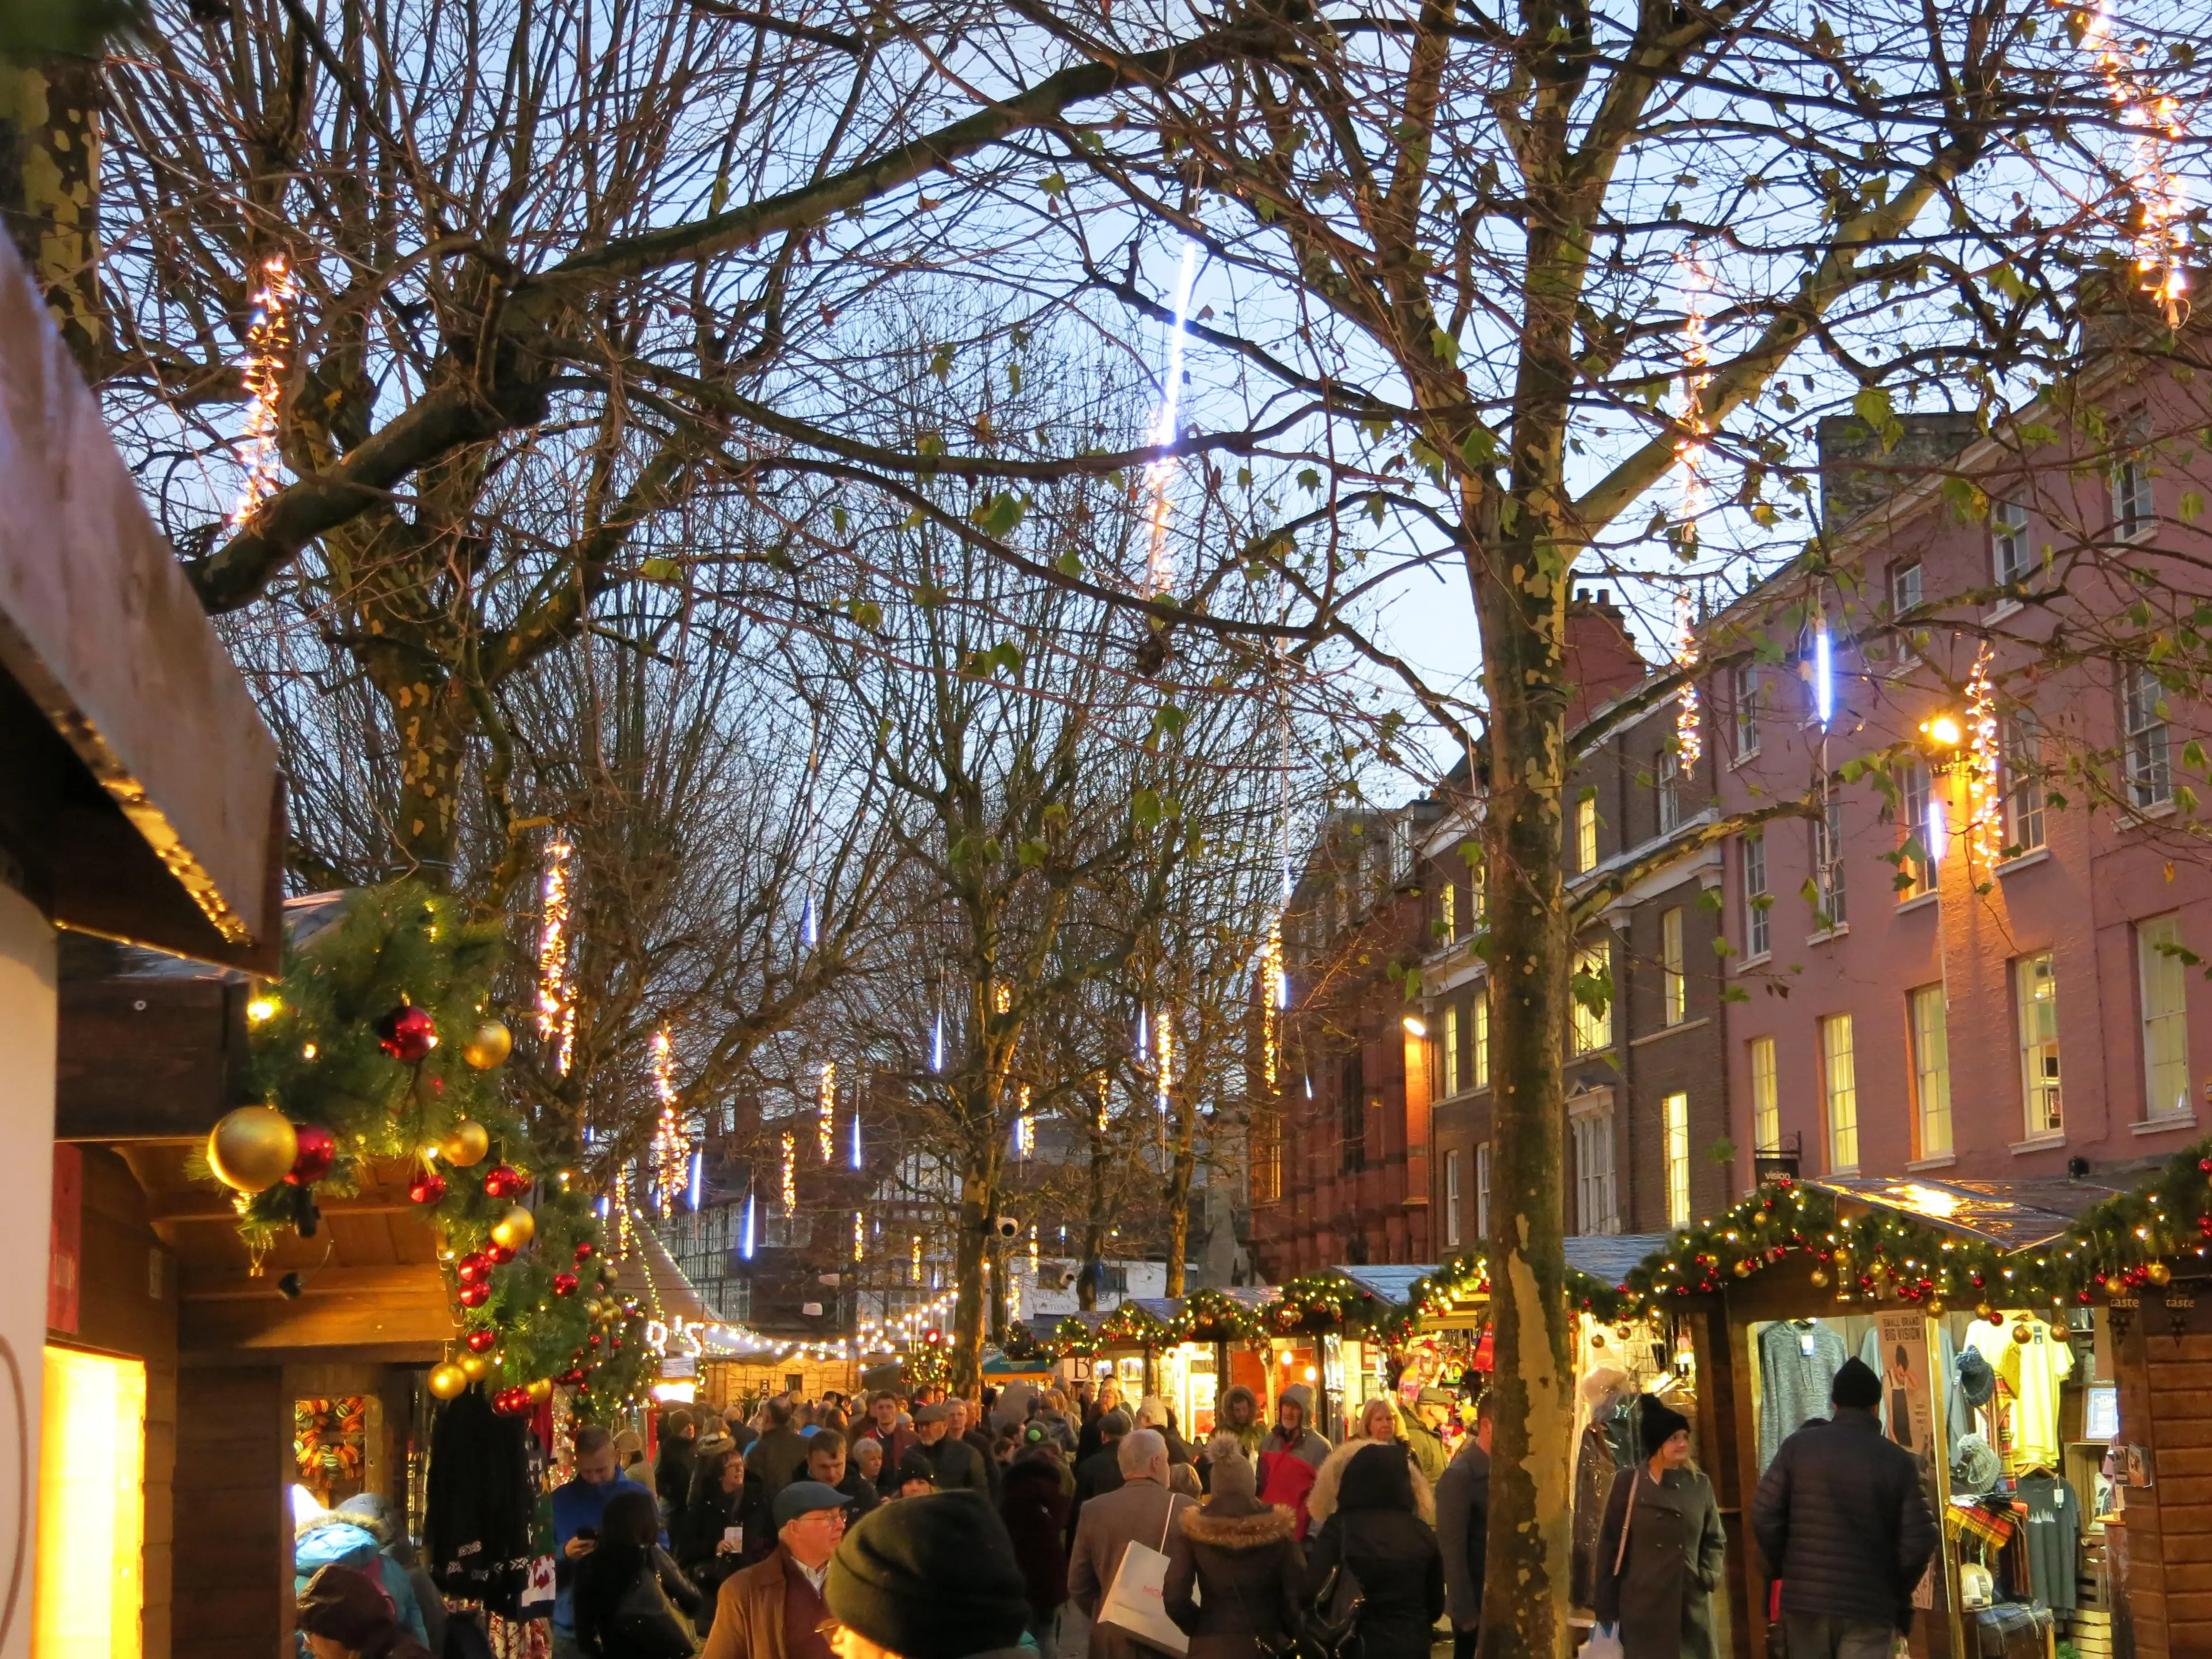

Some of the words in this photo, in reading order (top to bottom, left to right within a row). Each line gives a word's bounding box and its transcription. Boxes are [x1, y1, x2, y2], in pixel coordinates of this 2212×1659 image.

[1764, 1171, 1790, 1180] vision
[2110, 1298, 2139, 1308] taste
[2166, 1298, 2195, 1308] taste
[1885, 1328, 1896, 1341] BIG
[1897, 1327, 1921, 1340] VISION
